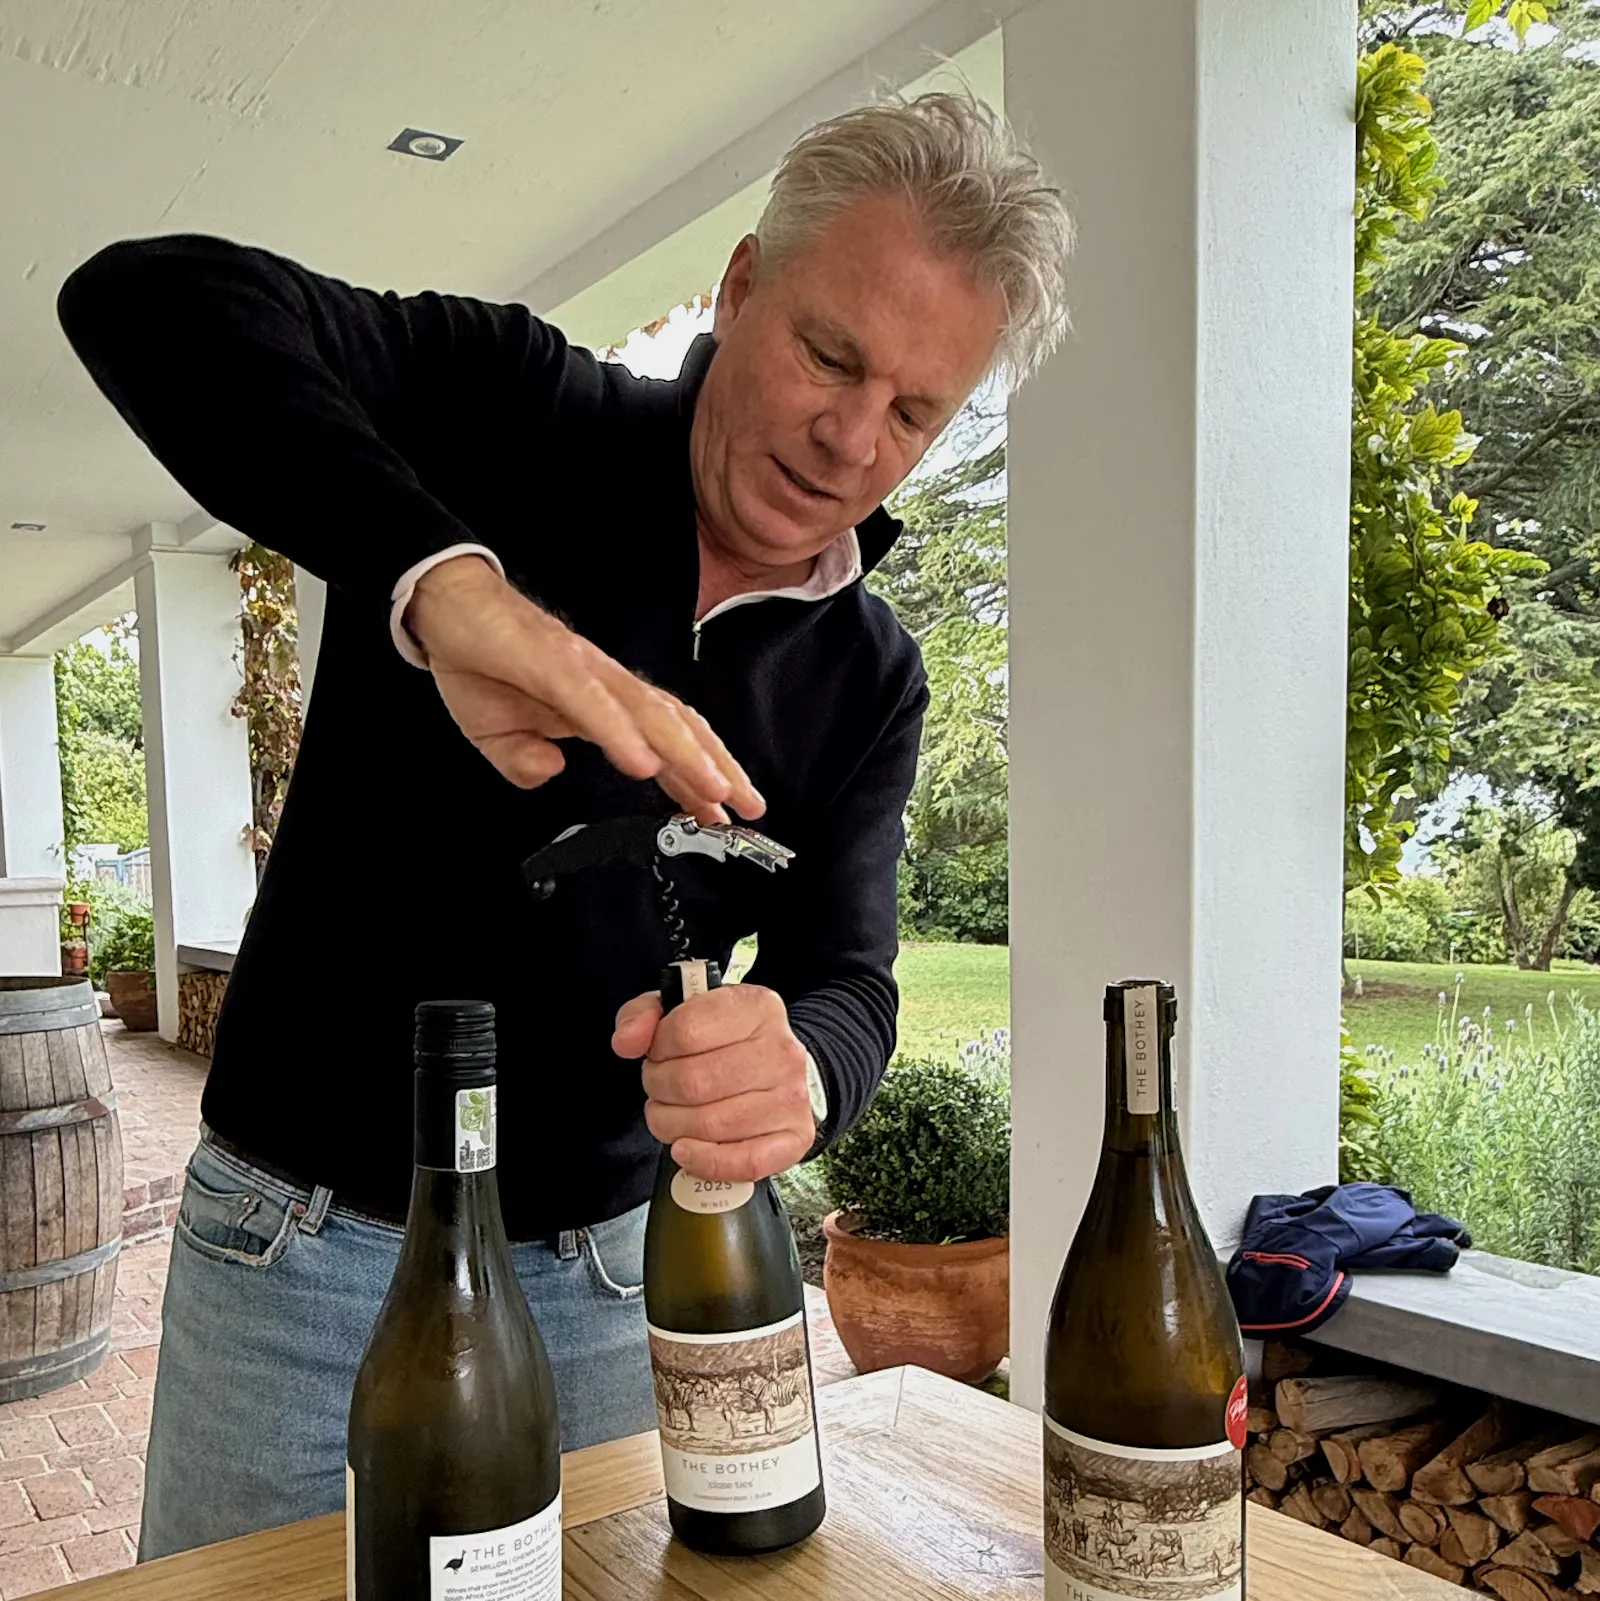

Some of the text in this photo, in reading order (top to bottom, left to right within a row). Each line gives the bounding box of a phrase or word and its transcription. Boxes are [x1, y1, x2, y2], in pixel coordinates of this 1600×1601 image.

[1135, 1000, 1147, 1096] THE BOTHEY
[694, 1181, 732, 1193] 2025
[700, 1200, 729, 1209] WINES
[682, 1456, 780, 1475] THE BOTHEY
[472, 1543, 506, 1561] THE
[514, 1517, 557, 1551] BOTHEY
[470, 1559, 507, 1574] SEMILLON
